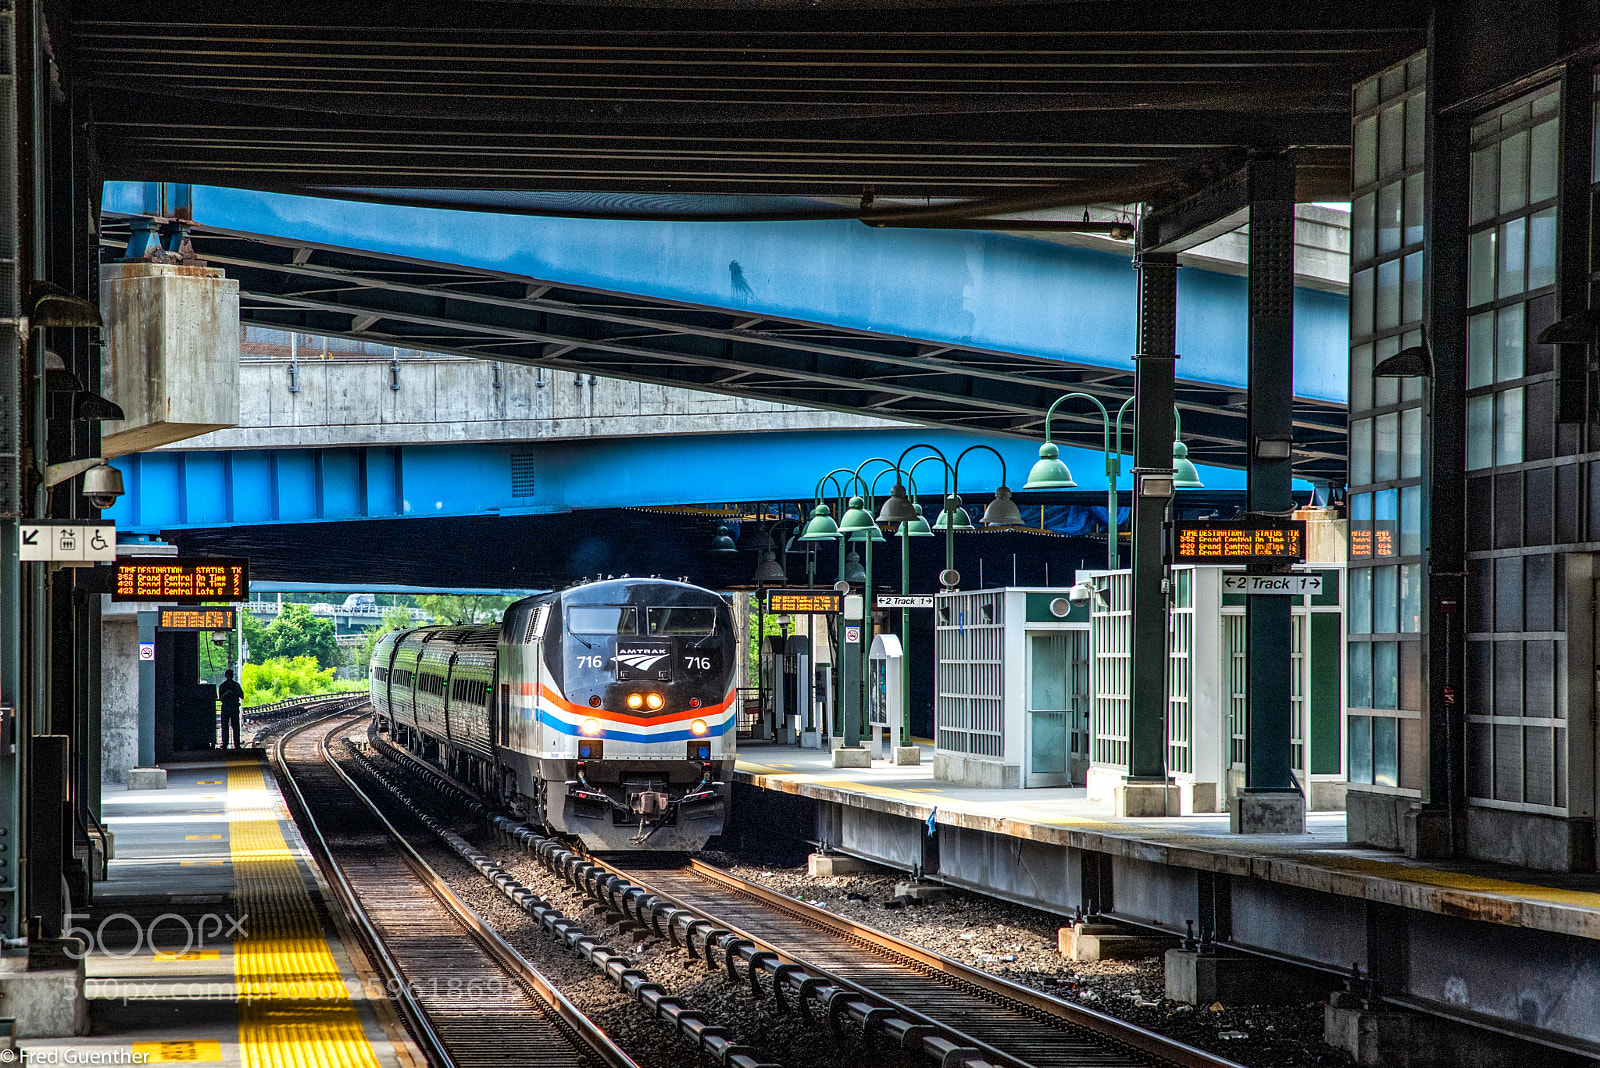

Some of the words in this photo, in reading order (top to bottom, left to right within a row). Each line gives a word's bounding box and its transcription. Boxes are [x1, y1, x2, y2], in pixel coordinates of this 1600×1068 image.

[1237, 577, 1246, 588] 2
[1252, 577, 1290, 589] Track
[1300, 578, 1306, 589] 1
[577, 656, 602, 668] 716
[685, 656, 710, 670] 716
